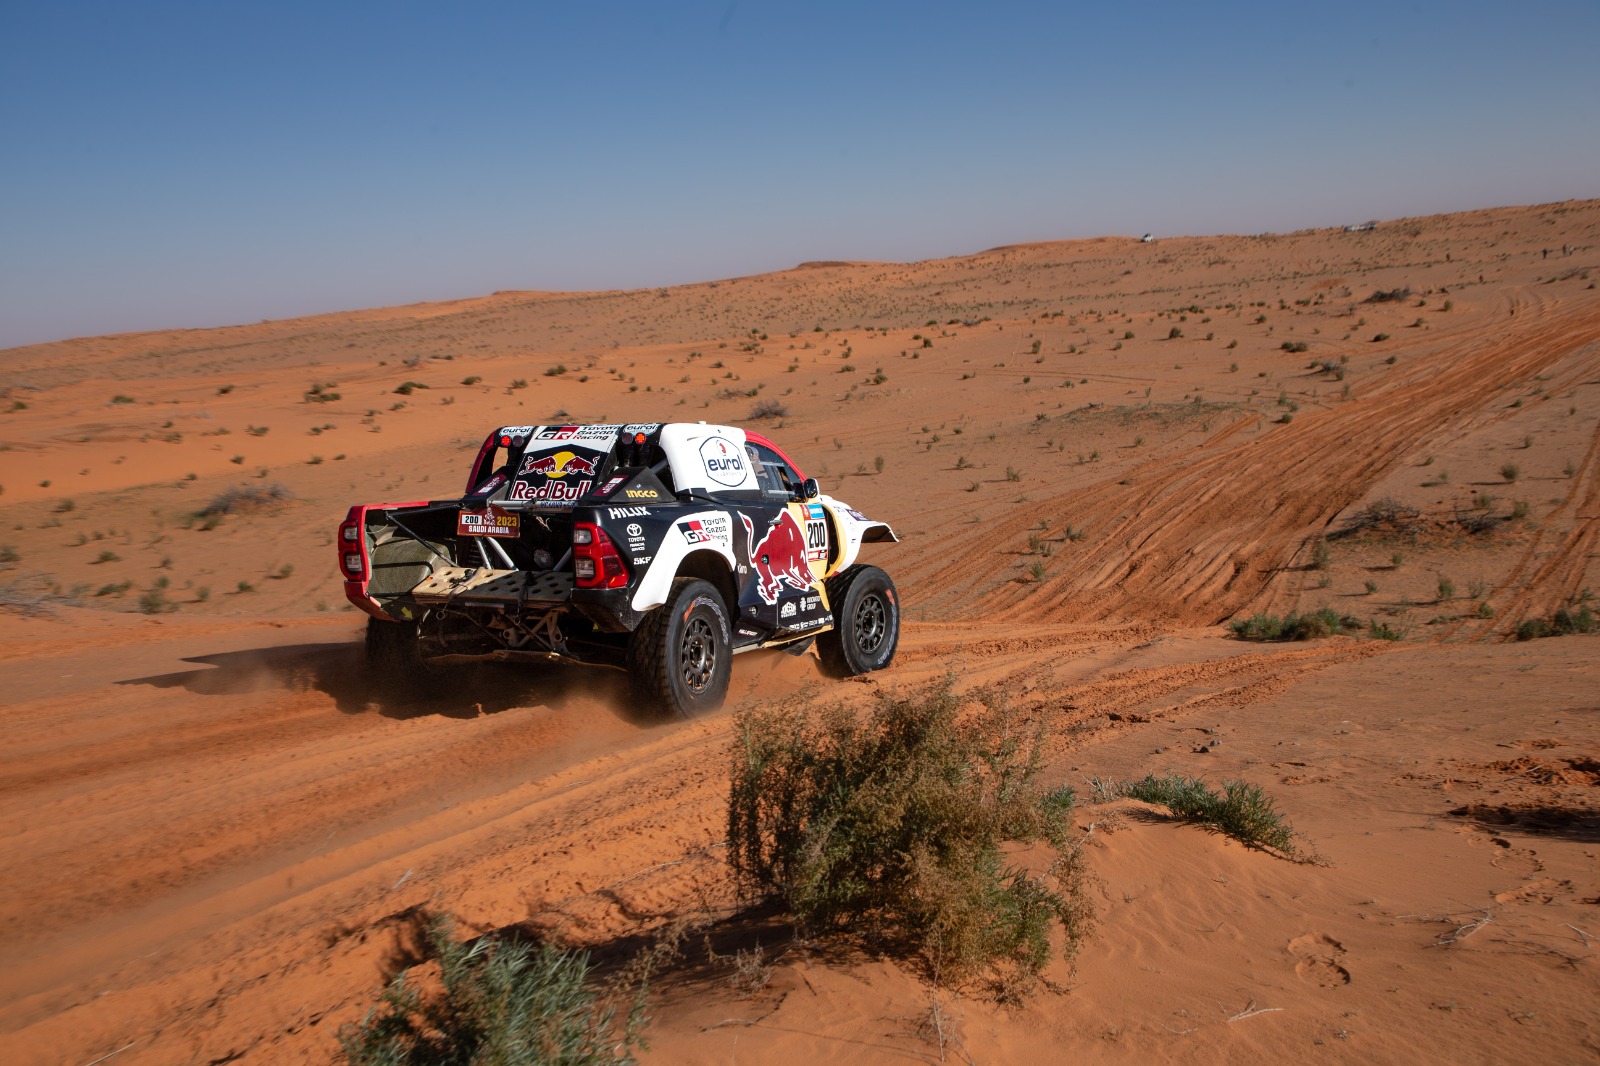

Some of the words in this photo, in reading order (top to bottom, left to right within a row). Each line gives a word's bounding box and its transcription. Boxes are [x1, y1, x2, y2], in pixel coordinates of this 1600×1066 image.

[536, 431, 574, 440] GR
[708, 454, 743, 471] eurol
[511, 480, 550, 500] Red
[551, 480, 592, 500] Bull
[608, 507, 651, 519] HILUX
[465, 515, 479, 524] 200
[497, 516, 517, 527] 2023
[702, 518, 726, 526] TOYOTA
[469, 525, 486, 533] SAUDI
[487, 526, 510, 534] ARABIA
[808, 522, 826, 548] 200
[683, 529, 711, 544] GR
[633, 556, 652, 565] SKF
